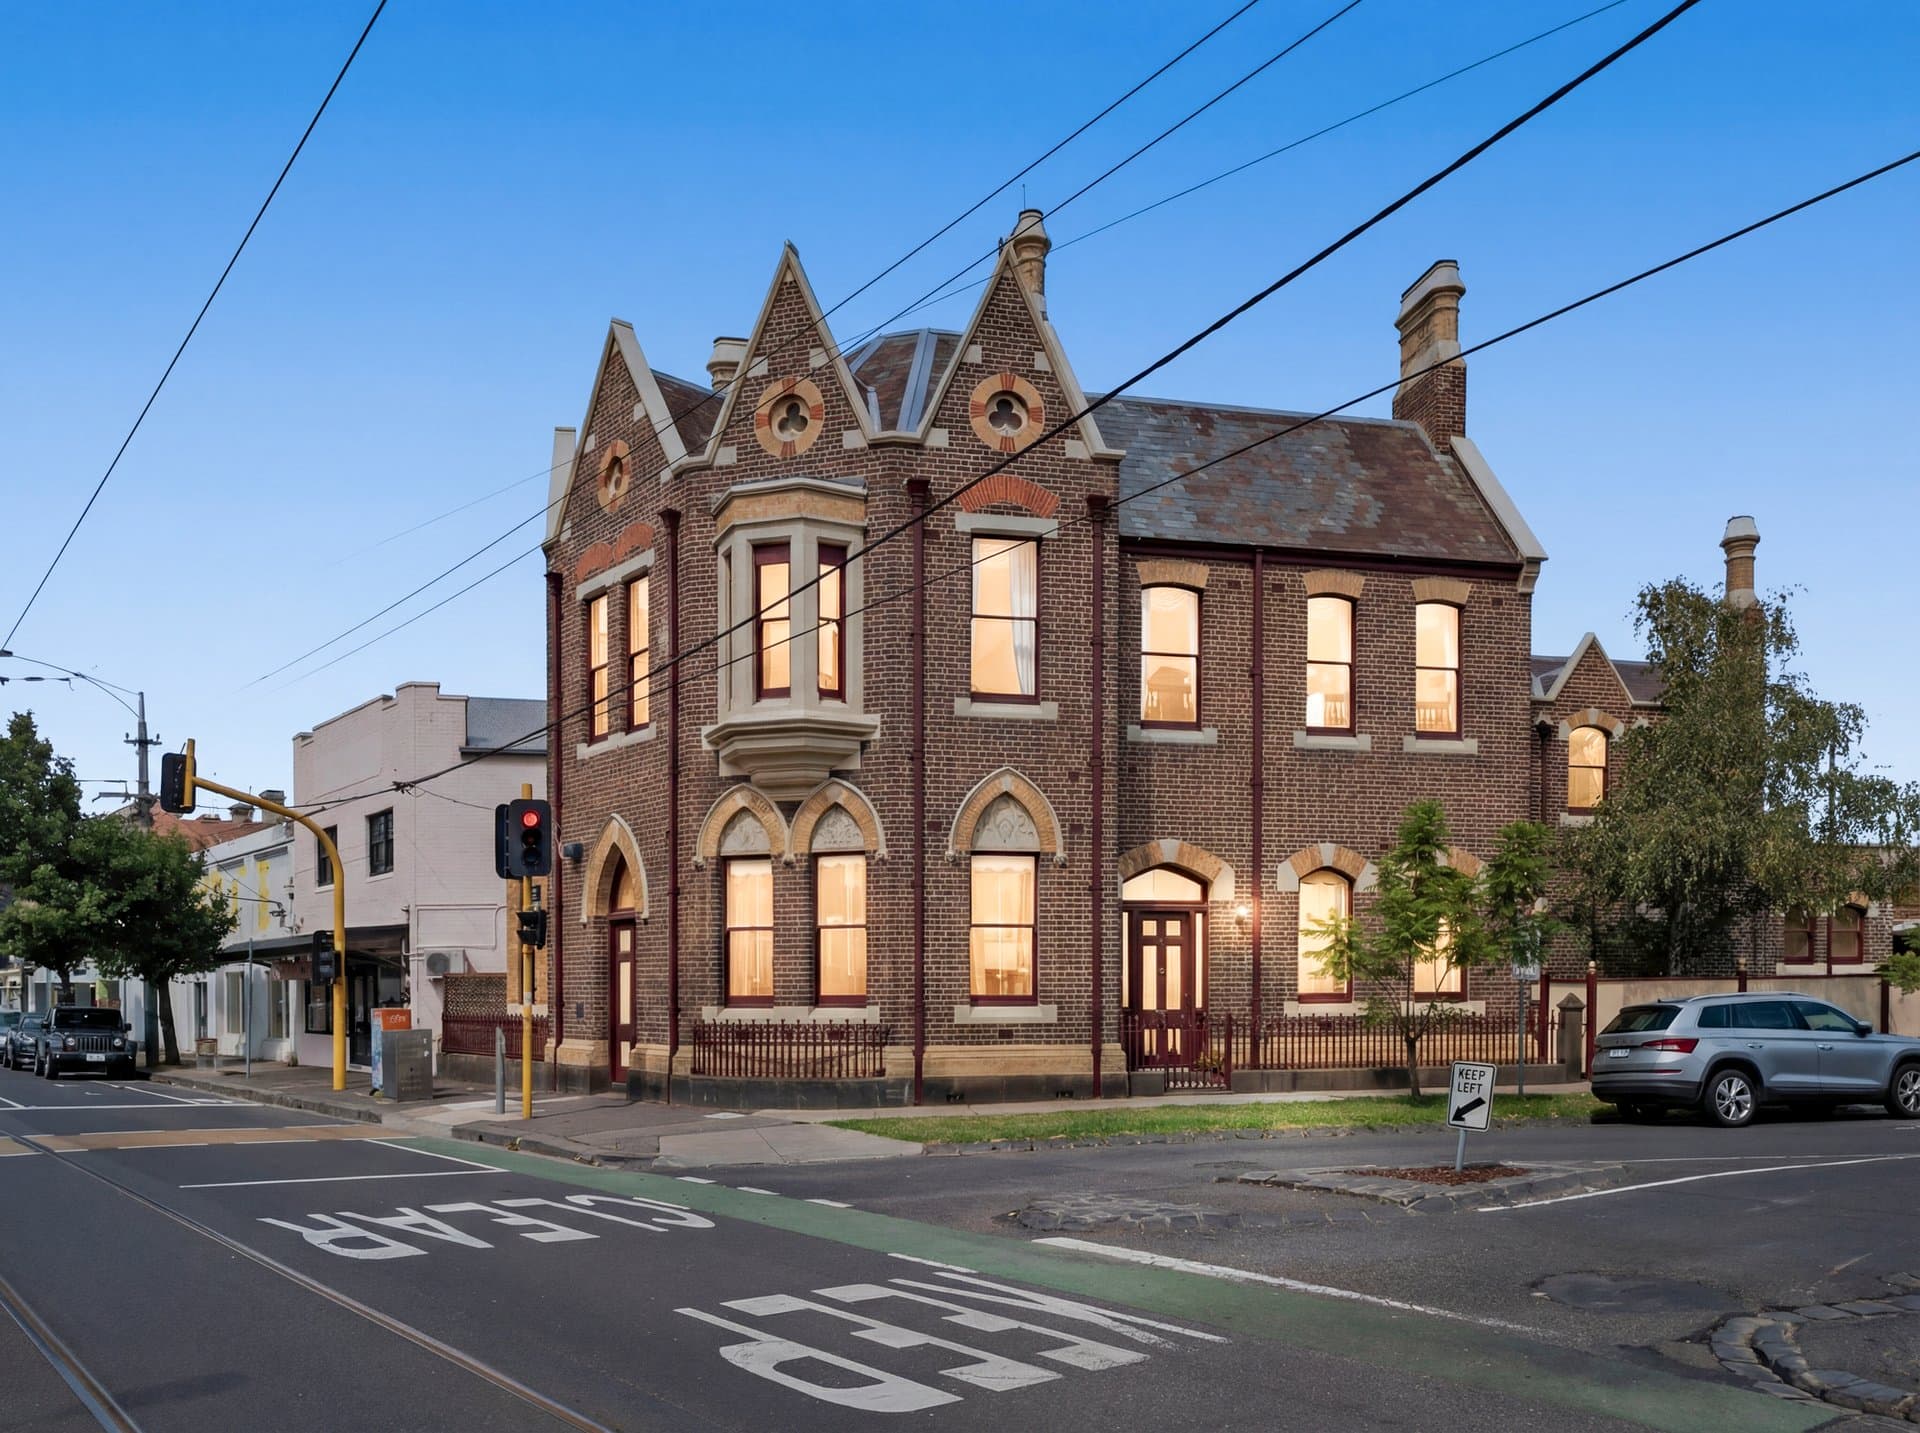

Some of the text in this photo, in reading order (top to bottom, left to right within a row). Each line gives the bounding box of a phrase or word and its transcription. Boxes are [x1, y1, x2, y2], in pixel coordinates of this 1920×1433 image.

[1457, 1081, 1483, 1095] LEFT
[1458, 1068, 1486, 1081] KEEP
[256, 1194, 716, 1260] CLEAR
[672, 1271, 1233, 1413] KEEP
